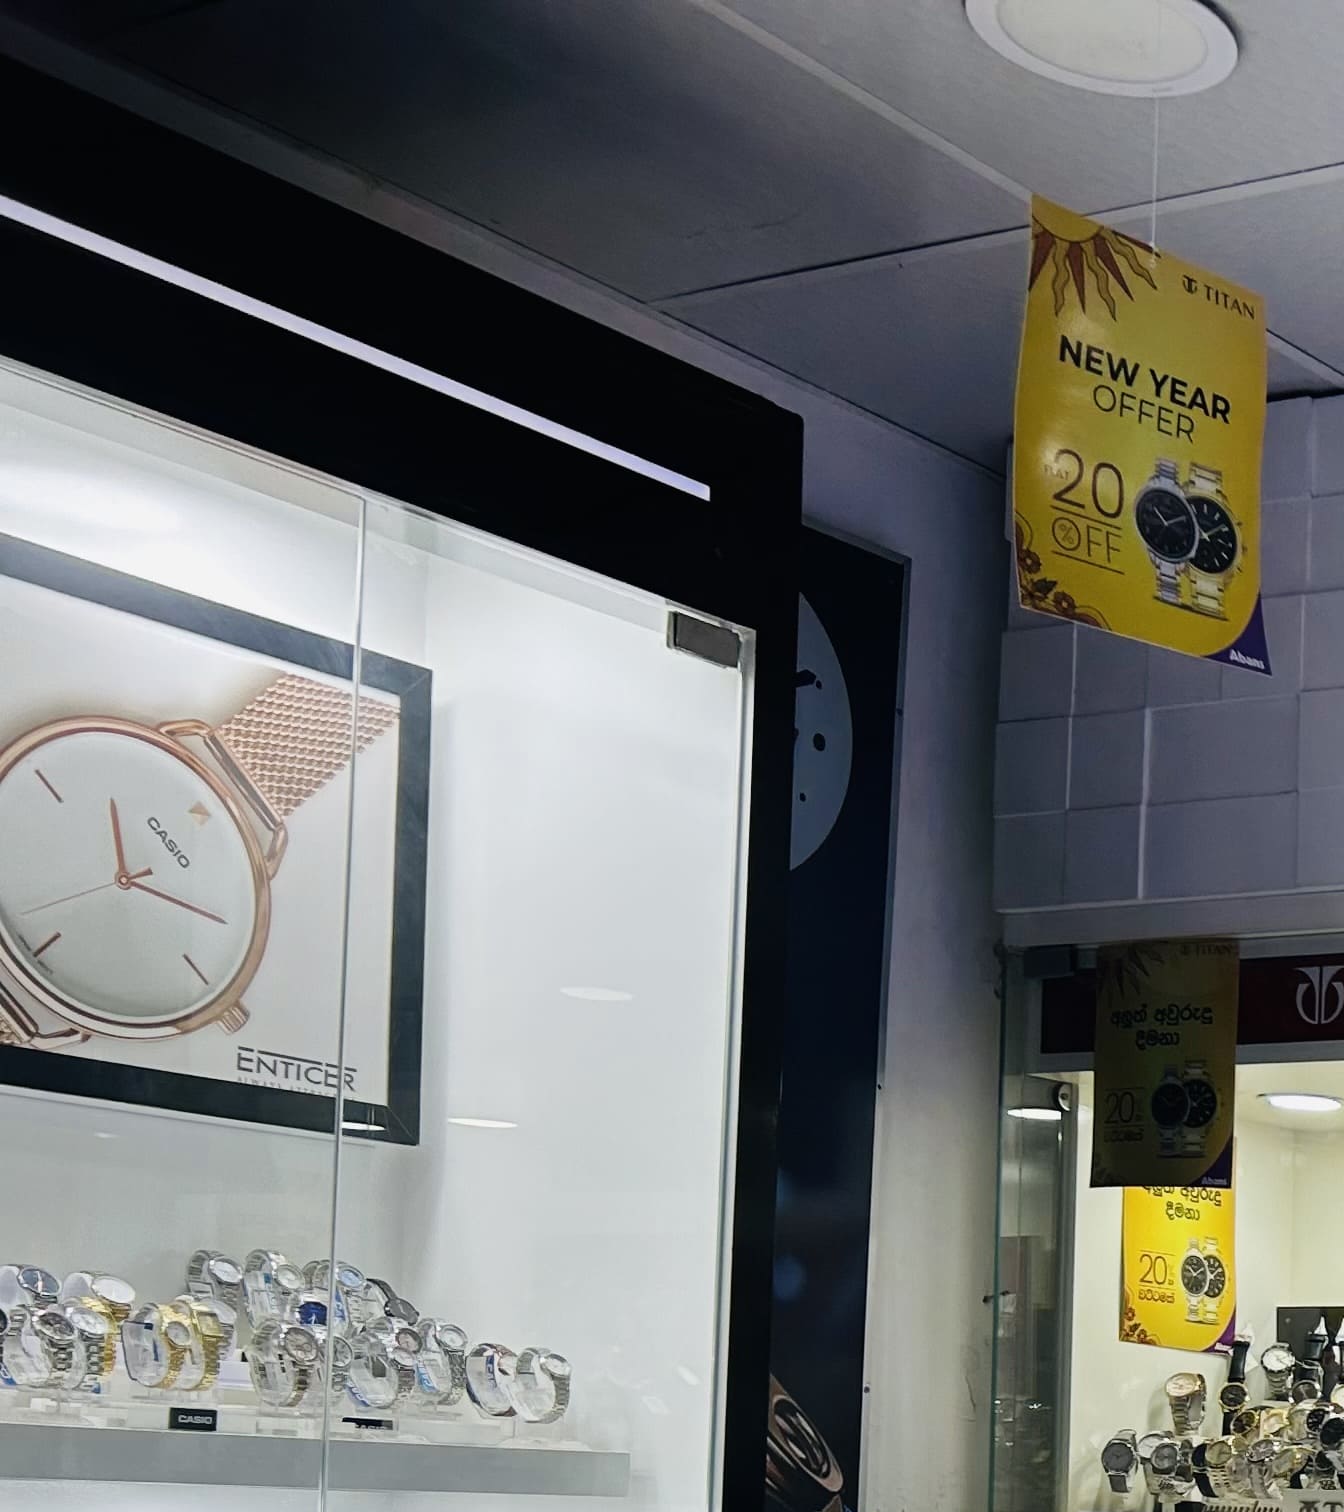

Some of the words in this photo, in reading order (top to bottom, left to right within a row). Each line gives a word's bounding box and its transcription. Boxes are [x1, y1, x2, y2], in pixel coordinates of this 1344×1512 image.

[1203, 284, 1256, 320] TITAN
[1058, 334, 1139, 387] NEW
[1150, 367, 1231, 425] YEAR
[1092, 384, 1195, 443] OFFER
[1051, 448, 1125, 520] 20
[1229, 646, 1265, 670] Abans
[147, 816, 190, 869] CASIO
[237, 1046, 358, 1092] ENTICER
[178, 1415, 213, 1425] CASIO
